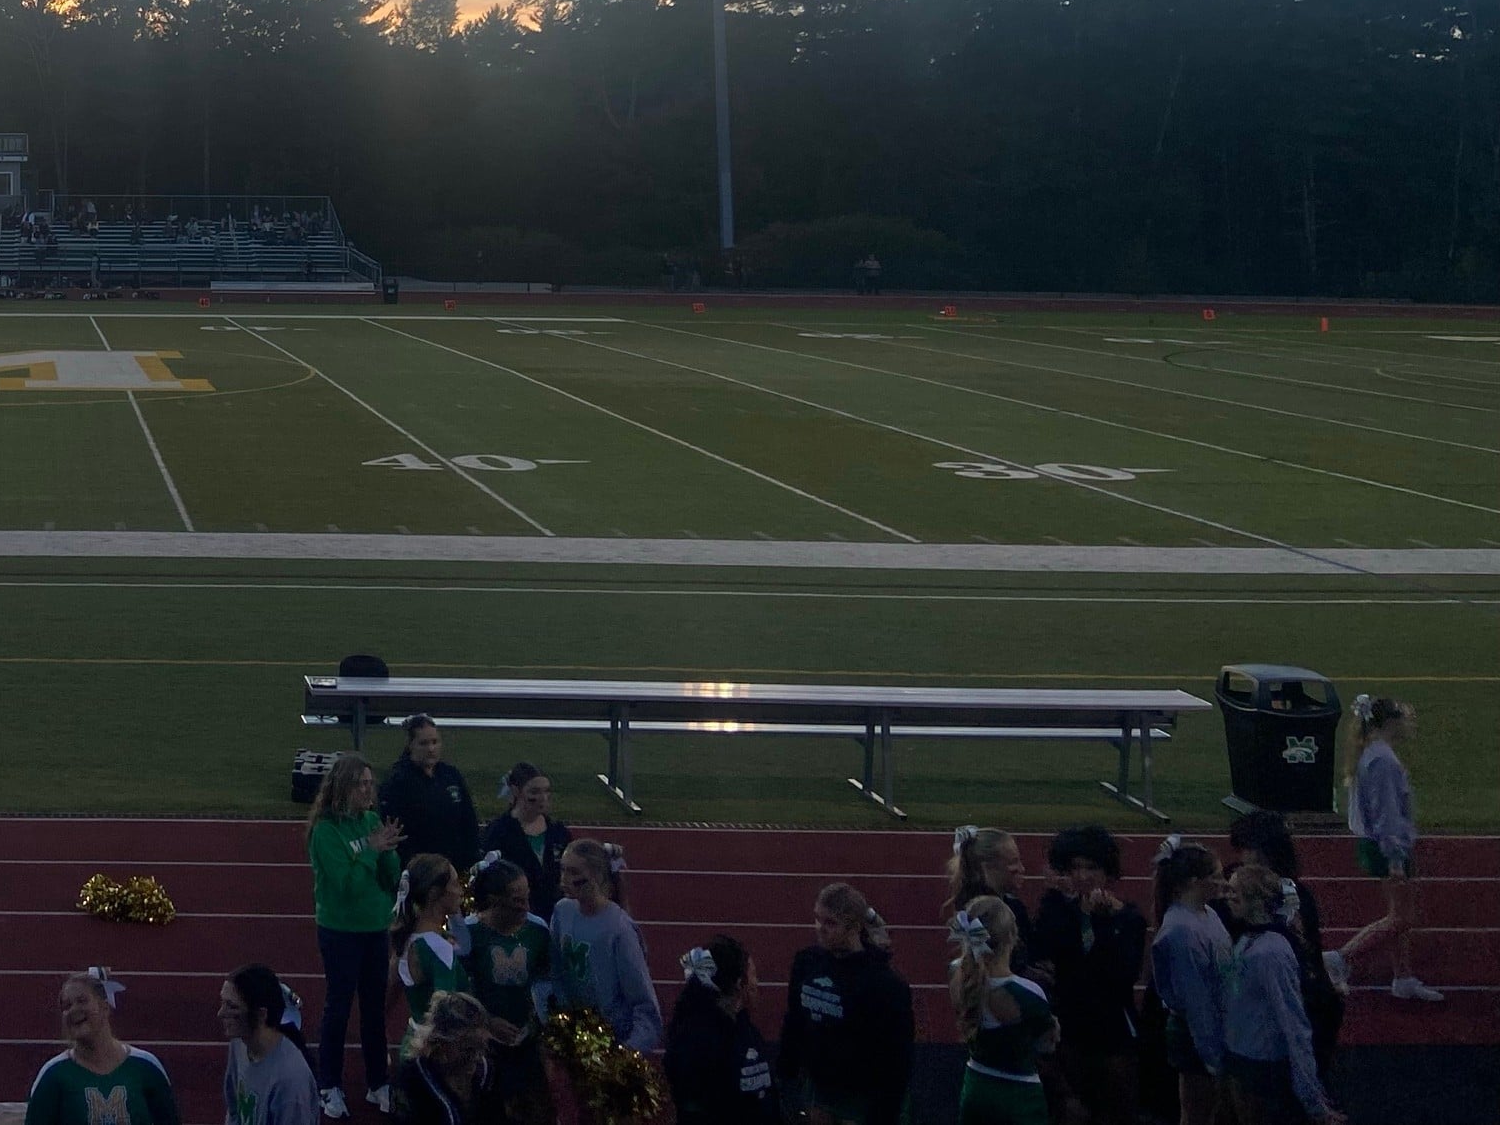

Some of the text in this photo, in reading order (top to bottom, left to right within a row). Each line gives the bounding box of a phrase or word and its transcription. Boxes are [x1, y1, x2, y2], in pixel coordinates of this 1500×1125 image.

[361, 453, 538, 472] 40
[932, 461, 1137, 481] 30
[1285, 735, 1316, 764] M
[491, 944, 528, 986] M
